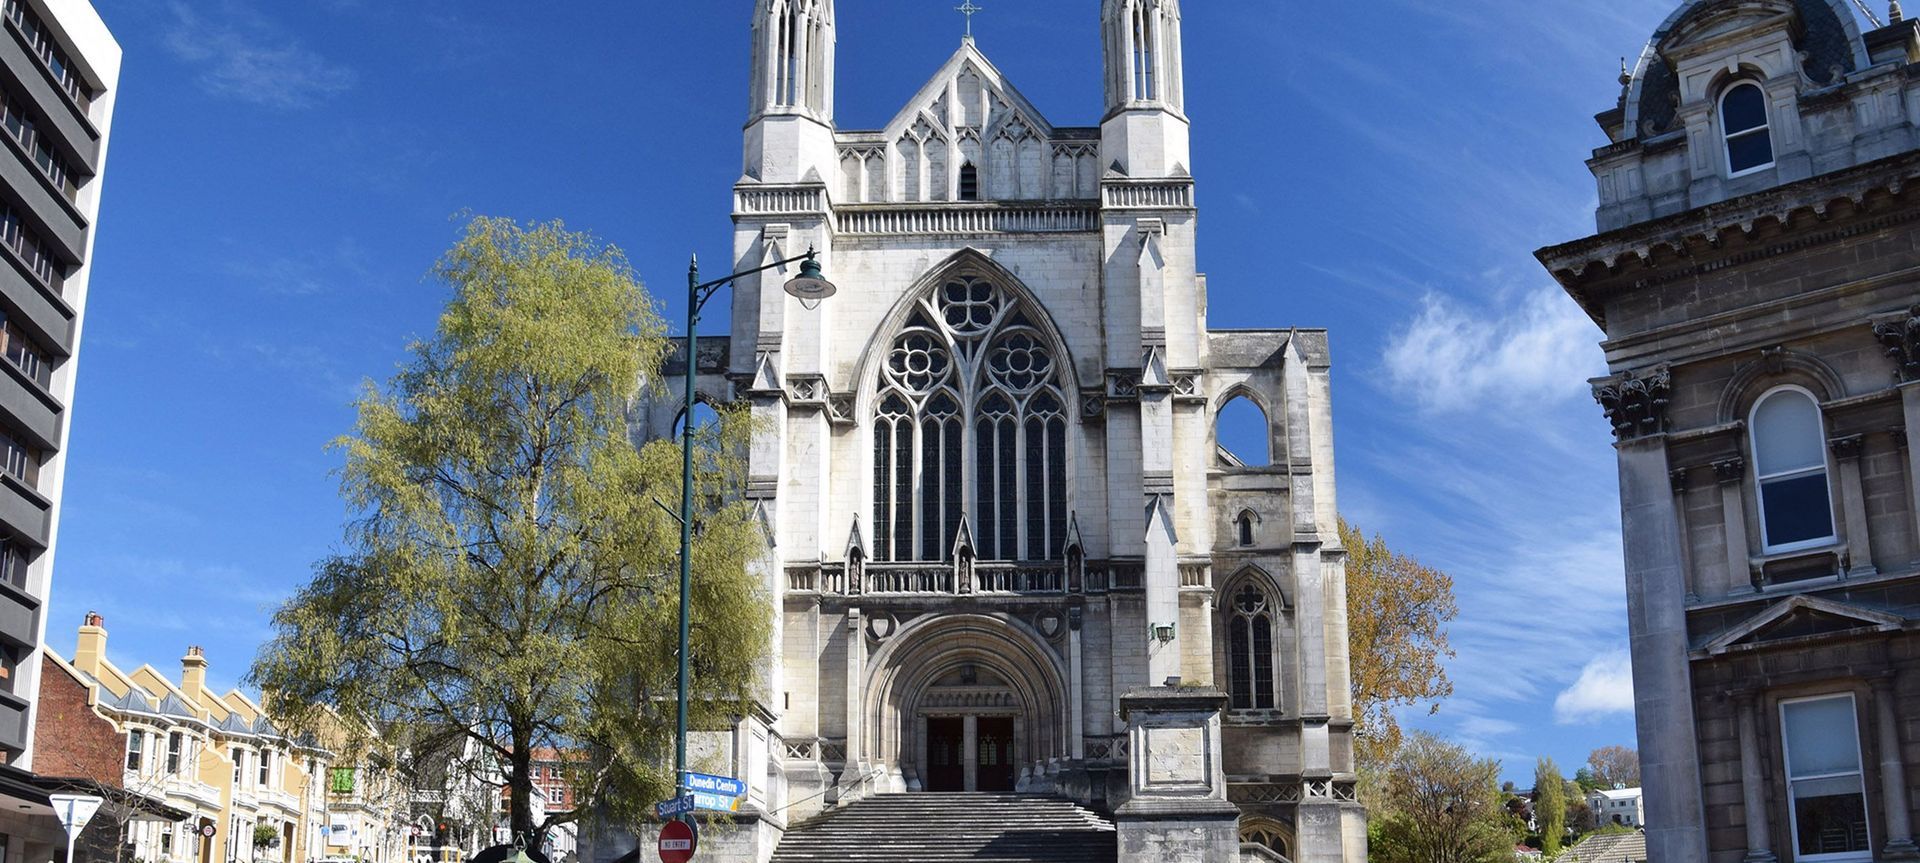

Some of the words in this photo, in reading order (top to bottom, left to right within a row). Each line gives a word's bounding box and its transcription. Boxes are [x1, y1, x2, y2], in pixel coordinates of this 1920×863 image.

[689, 775, 715, 789] Dunedin
[716, 779, 737, 792] Centre
[659, 800, 681, 816] Stuart
[682, 797, 692, 810] St
[694, 795, 715, 808] arrop
[718, 797, 729, 809] St
[672, 840, 686, 848] ENTRY
